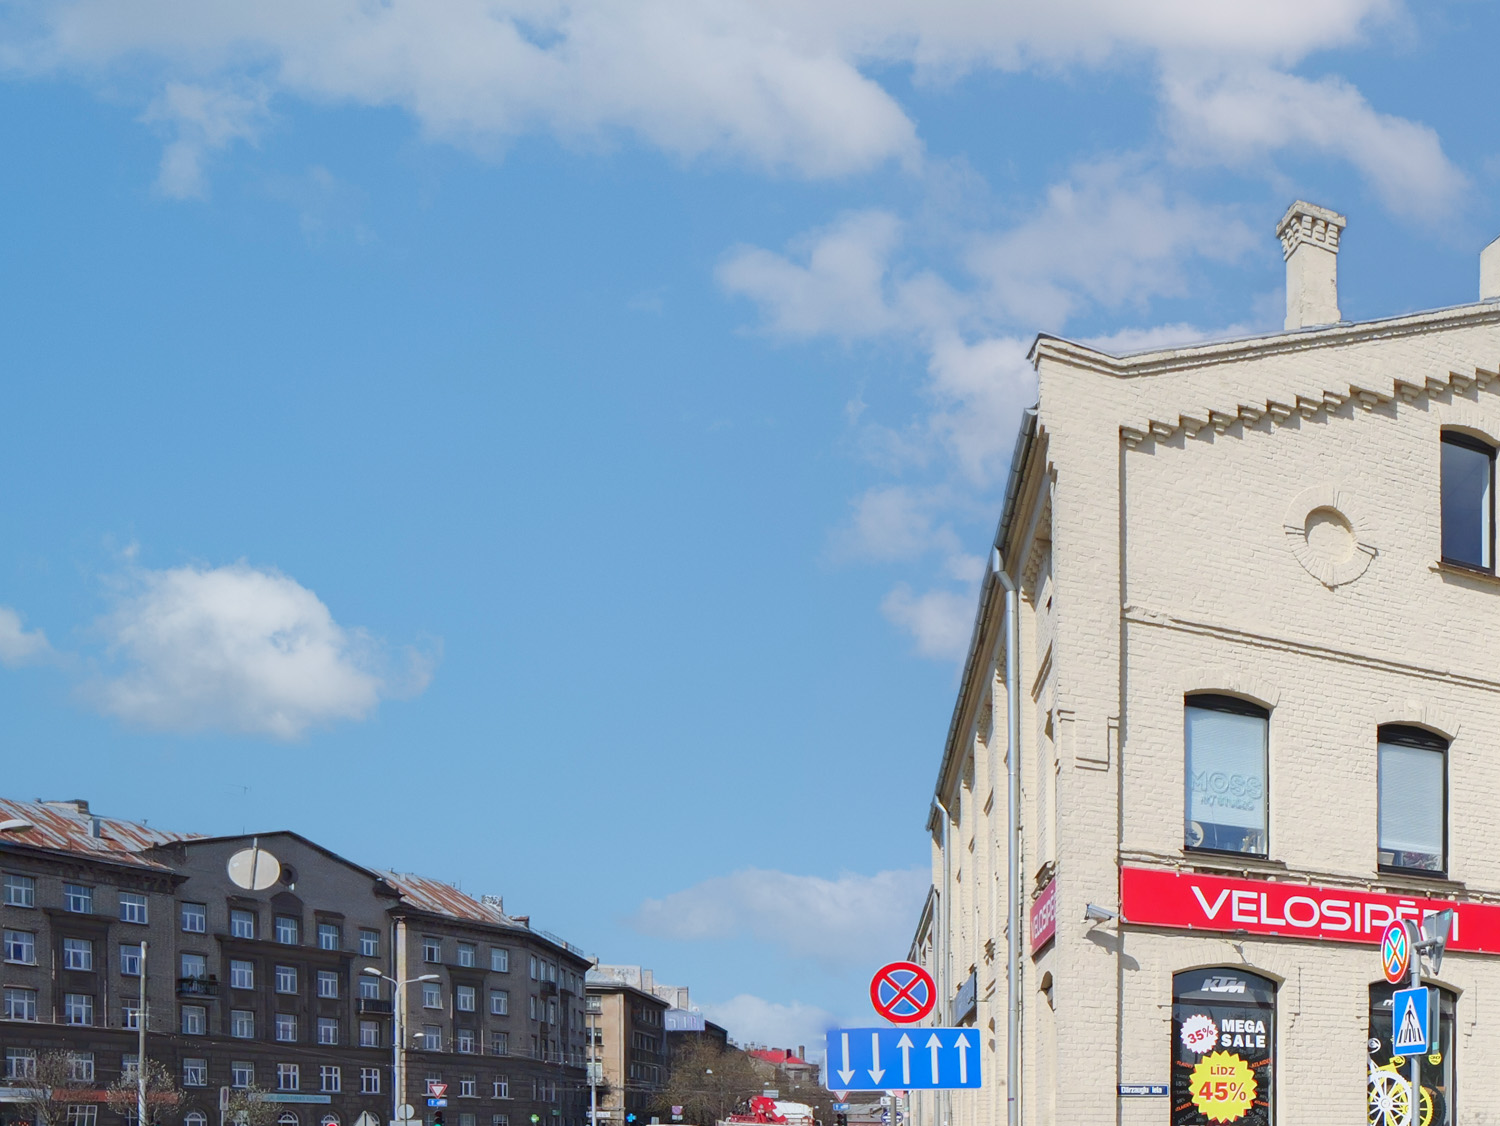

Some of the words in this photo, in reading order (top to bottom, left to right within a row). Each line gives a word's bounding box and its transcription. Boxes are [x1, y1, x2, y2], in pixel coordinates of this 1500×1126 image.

[1190, 885, 1460, 942] VELOSIPĒI
[1201, 976, 1246, 993] KTM
[1221, 1019, 1266, 1033] MEGA
[1187, 1026, 1214, 1044] 35%
[1220, 1034, 1266, 1048] SALE
[1210, 1064, 1235, 1075] LĪDZ
[1198, 1082, 1247, 1101] 45%
